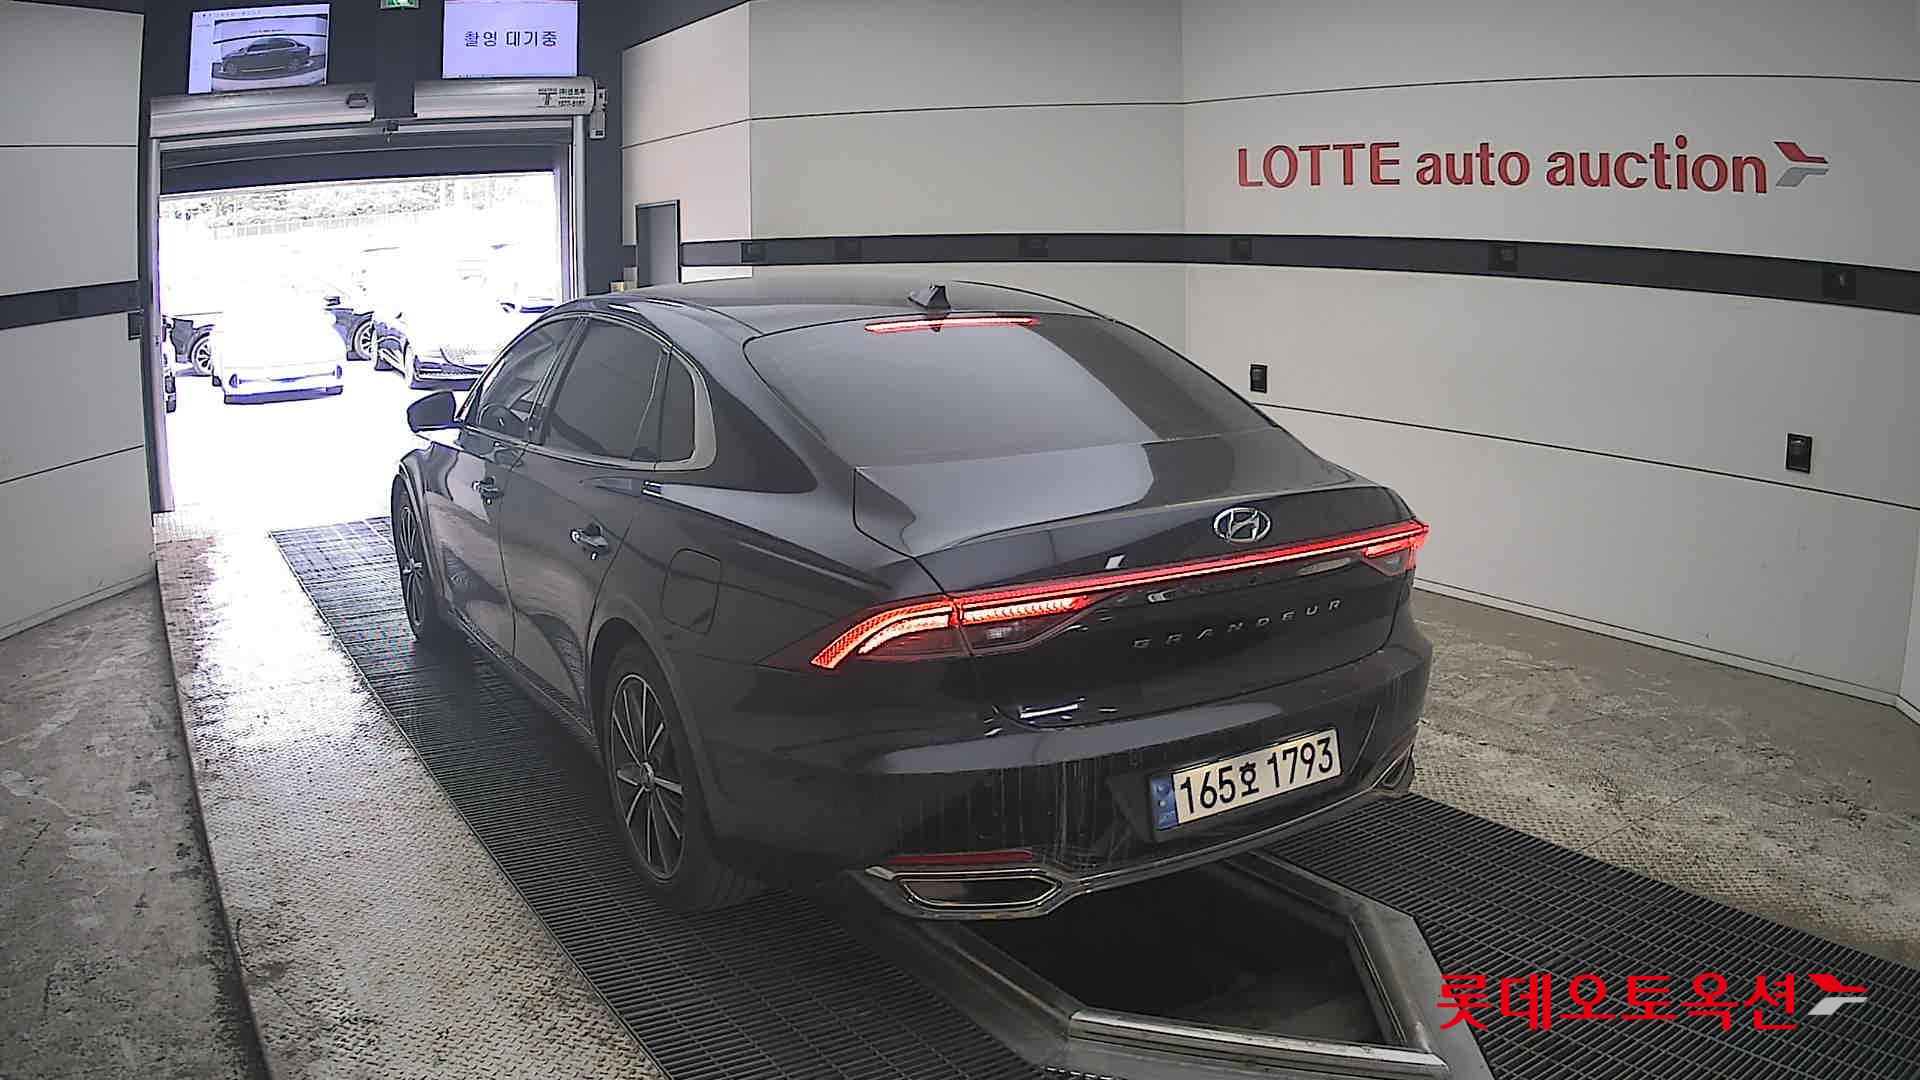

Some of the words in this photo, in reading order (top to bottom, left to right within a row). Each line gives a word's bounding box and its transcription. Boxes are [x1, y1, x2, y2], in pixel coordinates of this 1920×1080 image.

[505, 31, 558, 47] 대기중
[1237, 141, 1401, 188] LOTTE
[1416, 142, 1530, 187] auto
[1546, 134, 1768, 194] auction
[1179, 761, 1260, 815] 165호
[1266, 737, 1334, 789] 1793
